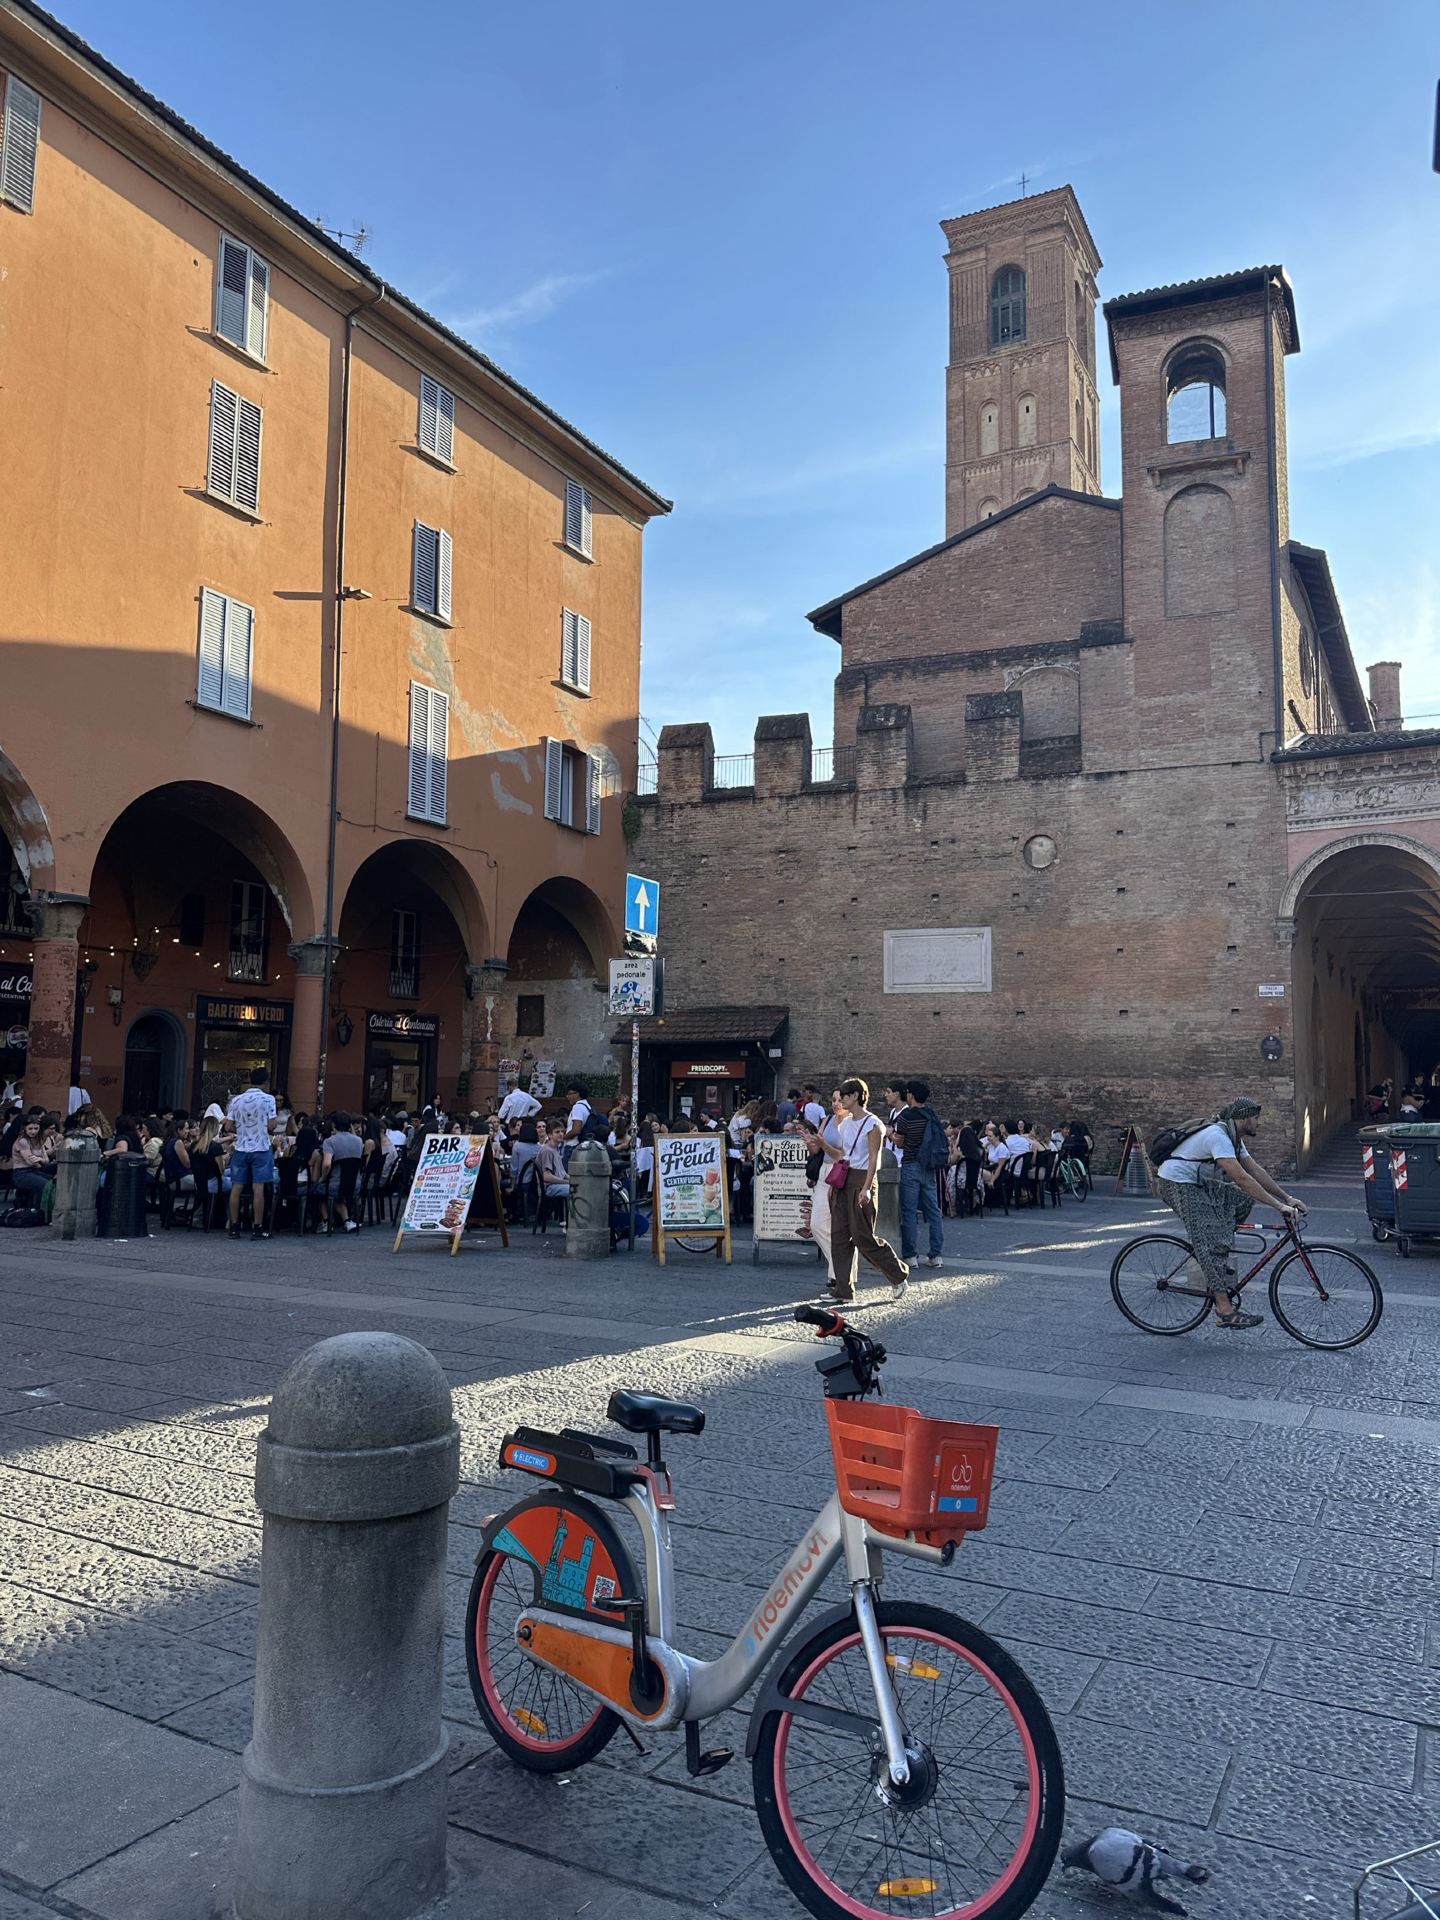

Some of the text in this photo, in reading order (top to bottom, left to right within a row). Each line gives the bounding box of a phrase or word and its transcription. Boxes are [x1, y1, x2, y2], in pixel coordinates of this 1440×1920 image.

[616, 971, 646, 979] pedonale
[0, 976, 15, 991] al
[207, 1002, 284, 1022] BAR FREUD VERDI
[426, 1137, 461, 1155] BAR
[669, 1140, 701, 1157] Bar
[780, 1140, 801, 1150] Bar
[420, 1151, 466, 1169] FREUD
[660, 1146, 716, 1176] Freud
[665, 1176, 702, 1187] CENTRIFUGHE
[519, 1453, 545, 1468] ELECTRIC
[951, 1483, 971, 1491] ridemovi
[753, 1531, 829, 1642] ridemovi
